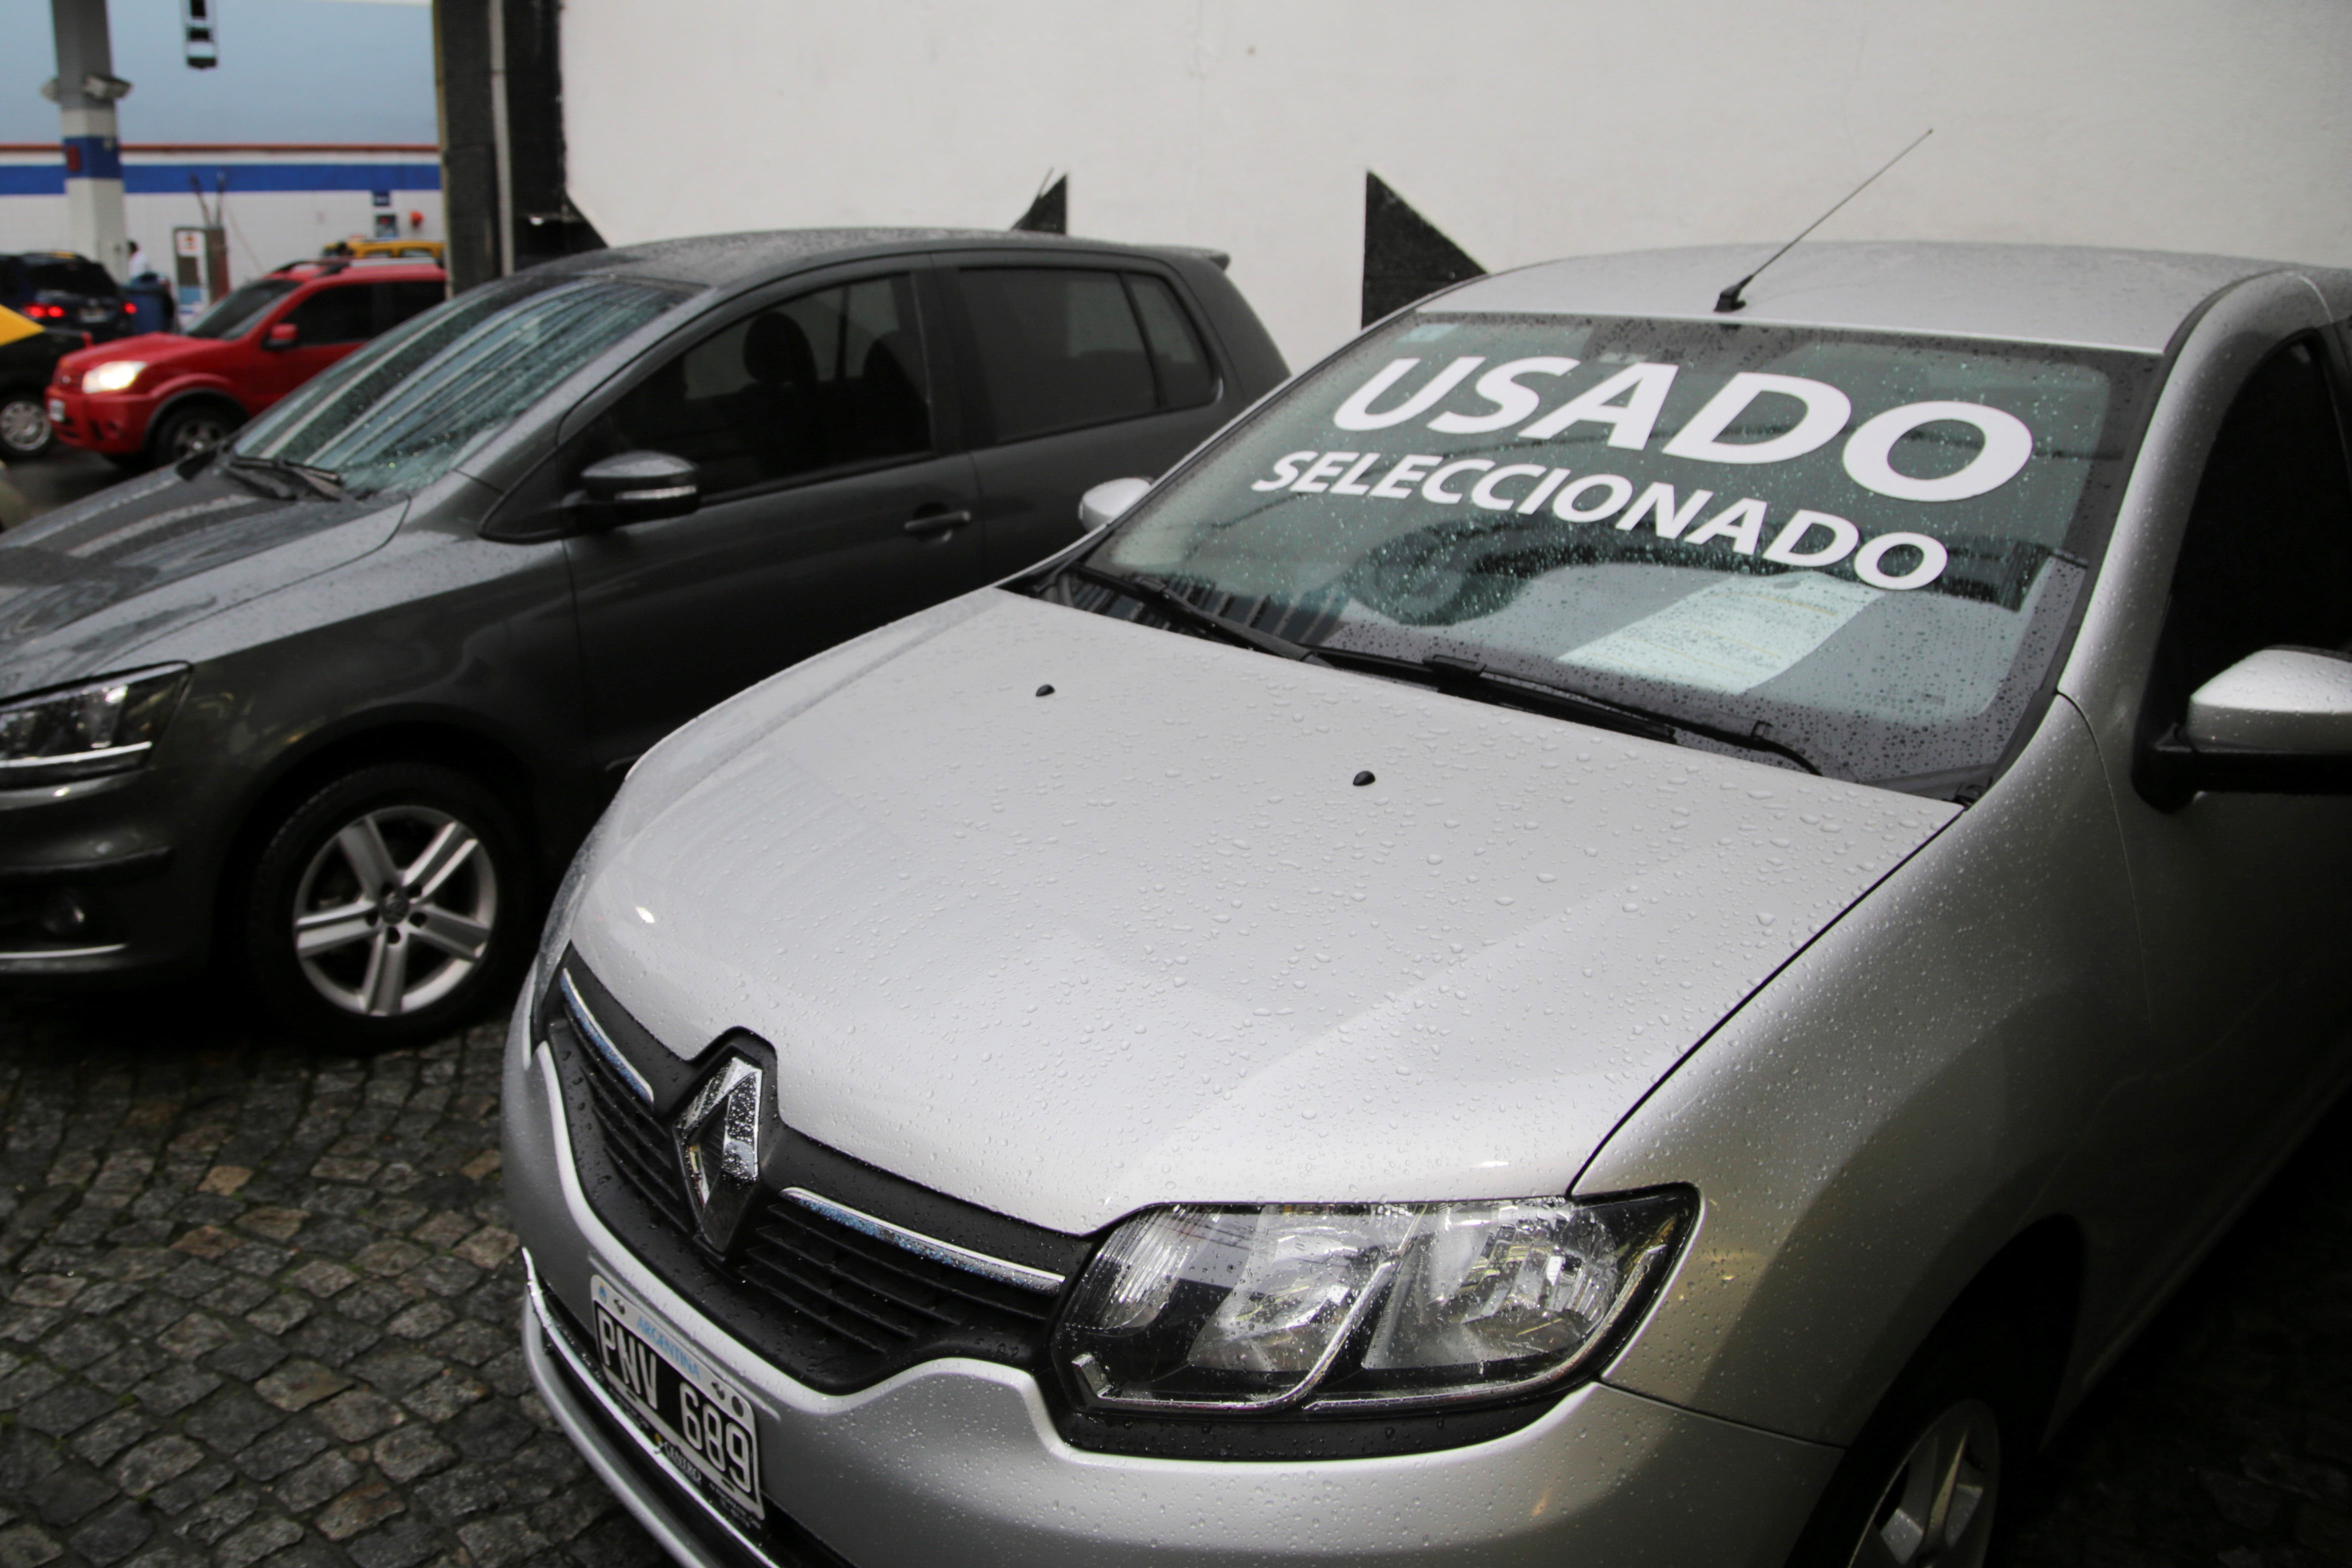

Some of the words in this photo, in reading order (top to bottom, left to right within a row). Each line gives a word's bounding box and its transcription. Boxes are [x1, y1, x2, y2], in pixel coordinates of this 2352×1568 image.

[1334, 356, 2033, 502] USADO
[1252, 451, 1948, 590] SELECCIONADO
[597, 1308, 658, 1410] PNV
[680, 1382, 752, 1493] 689
[636, 1316, 701, 1380] ARGENTINA
